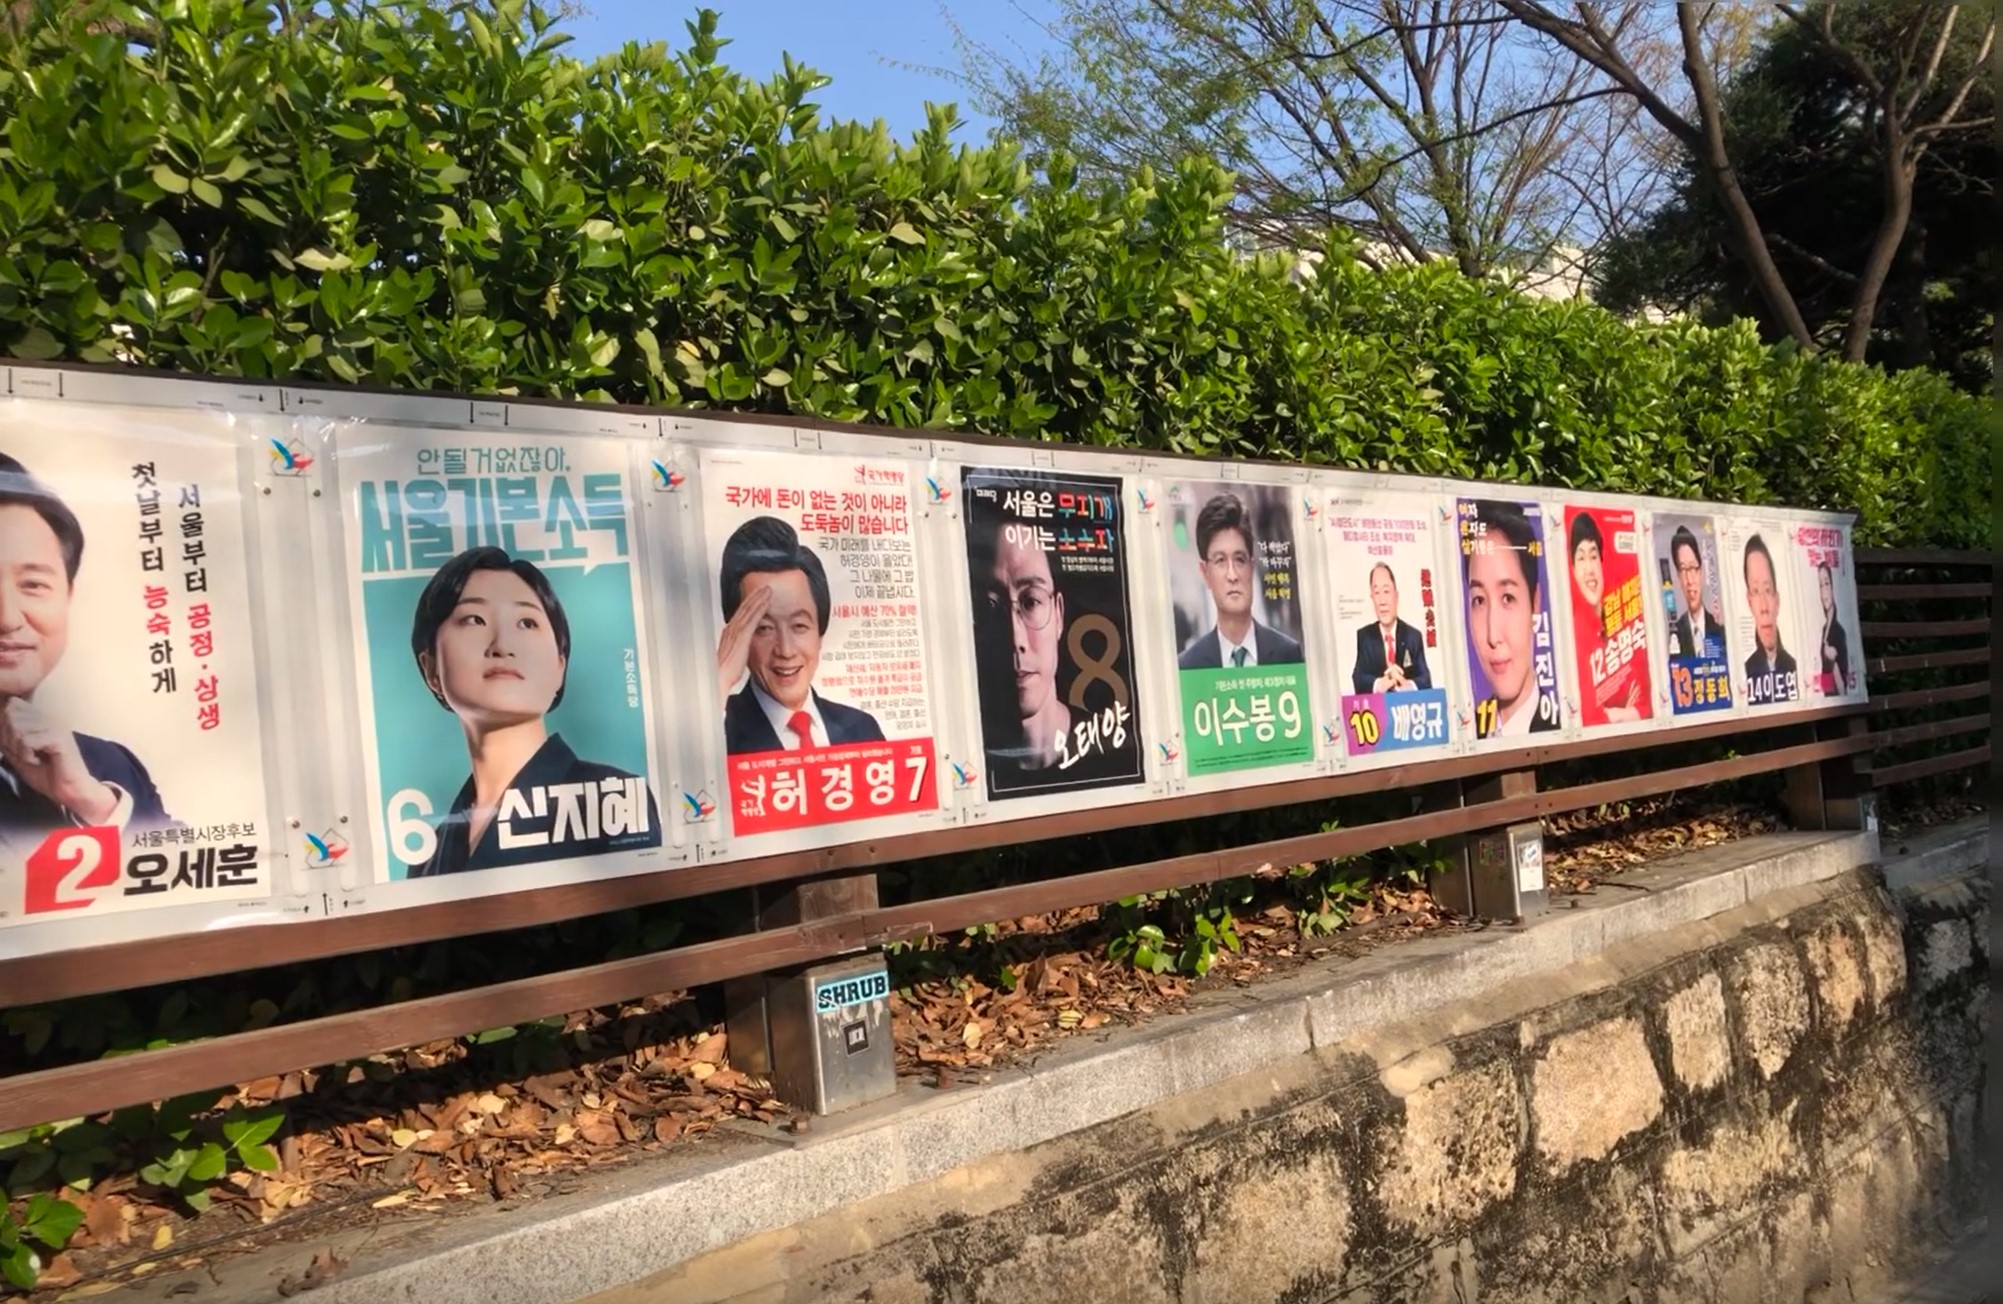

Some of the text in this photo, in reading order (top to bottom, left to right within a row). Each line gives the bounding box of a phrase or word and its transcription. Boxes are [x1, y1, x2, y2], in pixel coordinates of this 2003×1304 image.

[726, 486, 907, 514] 국가에 돈이 없는 것이 아니라
[1003, 490, 1055, 518] 서울은
[177, 484, 208, 593] 서울부터
[361, 474, 629, 573] 서울기본소득
[801, 513, 908, 535] 도둑놈이 많습니다
[1005, 524, 1056, 551] 이기는
[819, 537, 911, 552] 국가 미래를 내다보는
[841, 554, 880, 568] 허경영이
[131, 461, 178, 695] 첫날부터 능숙하게
[850, 570, 860, 583] 그
[863, 569, 891, 583] 나물에
[894, 569, 903, 583] 그
[855, 585, 874, 599] 이제
[832, 604, 859, 618] 서울시
[1067, 613, 1129, 713] 8
[1532, 611, 1559, 725] 김진아
[1590, 647, 1606, 687] 12
[1605, 620, 1647, 676] 송명숙
[1671, 667, 1693, 707] 13
[1747, 675, 1762, 702] 14
[1763, 671, 1799, 702] 이도엽
[1194, 694, 1276, 746] 이수봉
[1278, 691, 1302, 738] 9
[1350, 710, 1380, 746] 10
[1391, 702, 1443, 741] 배영규
[1477, 699, 1498, 735] 11
[1054, 701, 1130, 770] 오태양
[771, 759, 895, 816] 허경영
[905, 756, 928, 802] 7
[387, 788, 438, 865] 6
[497, 776, 650, 851] 신지혜
[131, 821, 257, 849] 서울특별시장후보
[53, 834, 102, 904] 2
[124, 844, 259, 897] 오세훈
[818, 975, 887, 1009] SHRUB
